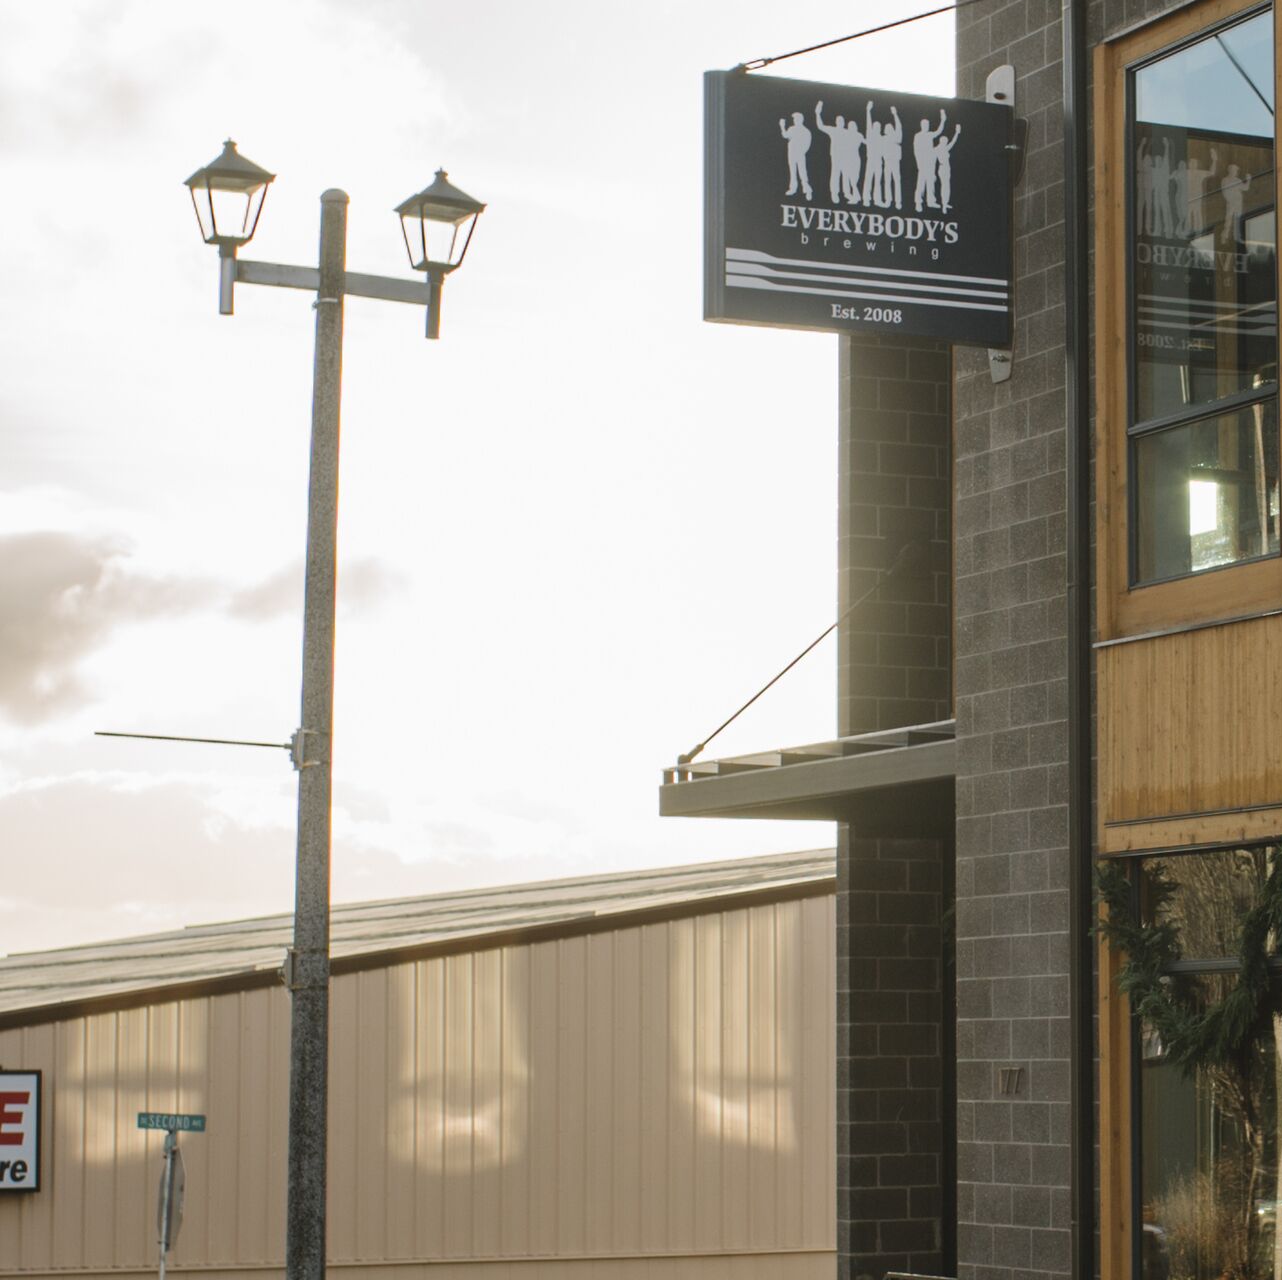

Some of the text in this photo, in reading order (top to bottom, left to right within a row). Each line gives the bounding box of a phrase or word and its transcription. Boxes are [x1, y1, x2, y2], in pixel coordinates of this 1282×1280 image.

[781, 204, 959, 243] EVERYBODY'S
[801, 232, 939, 259] brewing
[831, 303, 902, 323] Est. 2008
[149, 1115, 190, 1129] SECOND
